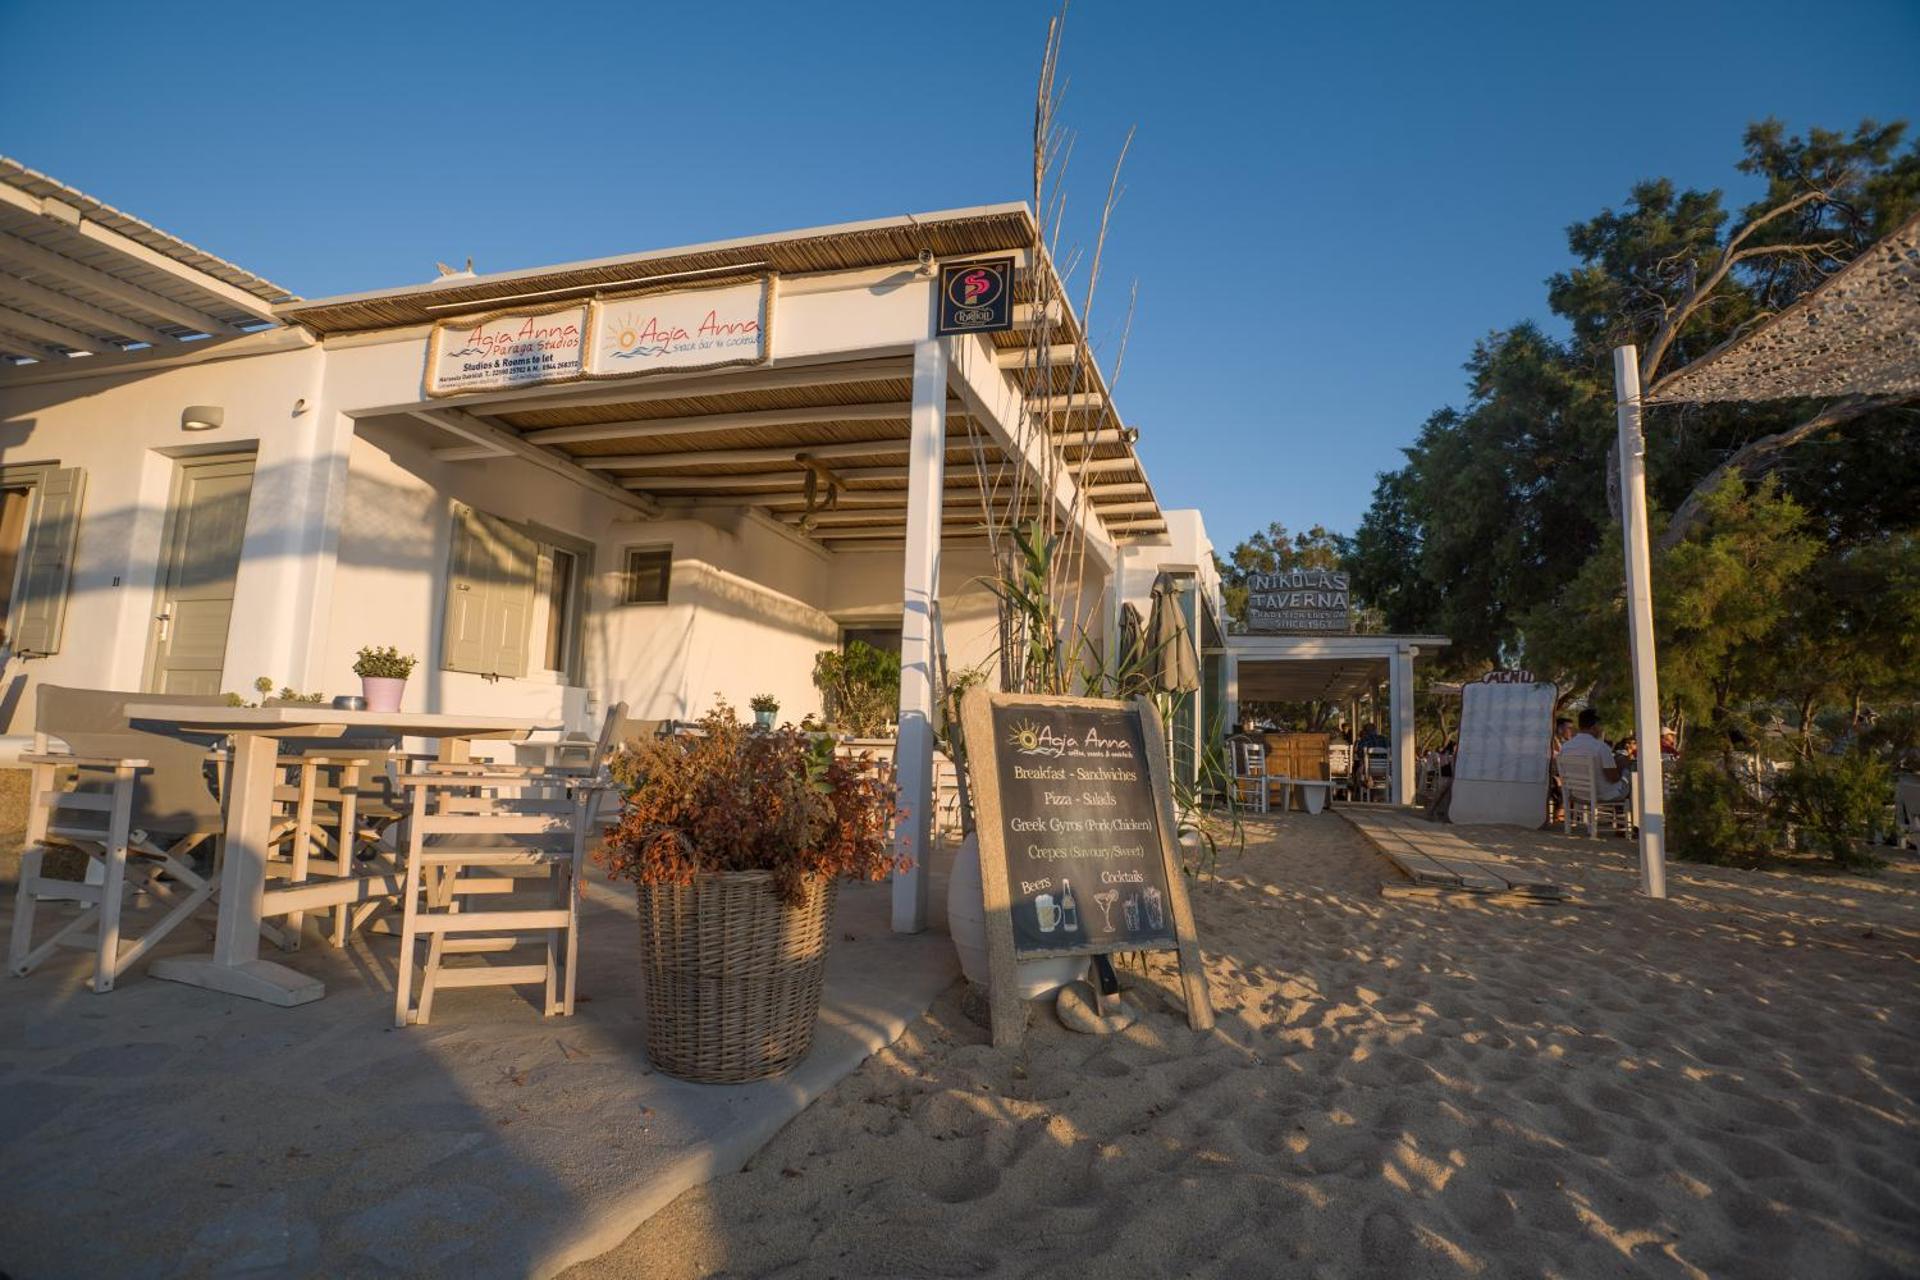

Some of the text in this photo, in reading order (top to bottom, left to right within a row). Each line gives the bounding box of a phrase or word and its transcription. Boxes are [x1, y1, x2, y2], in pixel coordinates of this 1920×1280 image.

[467, 316, 579, 359] Agia Anna
[639, 310, 762, 357] Agia Anna
[493, 337, 579, 357] Paraga Studios
[463, 353, 554, 372] Studios & Rooms to let
[1255, 573, 1348, 590] NIKOLAS
[1250, 592, 1348, 609] TAVERNA
[1488, 671, 1532, 683] MENU
[1038, 725, 1132, 759] Agia Anna
[1014, 766, 1066, 780] Breakfast
[1077, 767, 1137, 782] Sandwiches
[1044, 792, 1072, 805] Pizza
[1083, 792, 1117, 806] Salads
[1011, 818, 1047, 832] Greek
[1050, 818, 1083, 835] Gyros
[1028, 844, 1067, 862] Crepes
[1101, 870, 1144, 883] Cocktails
[1021, 877, 1052, 895] Beers
